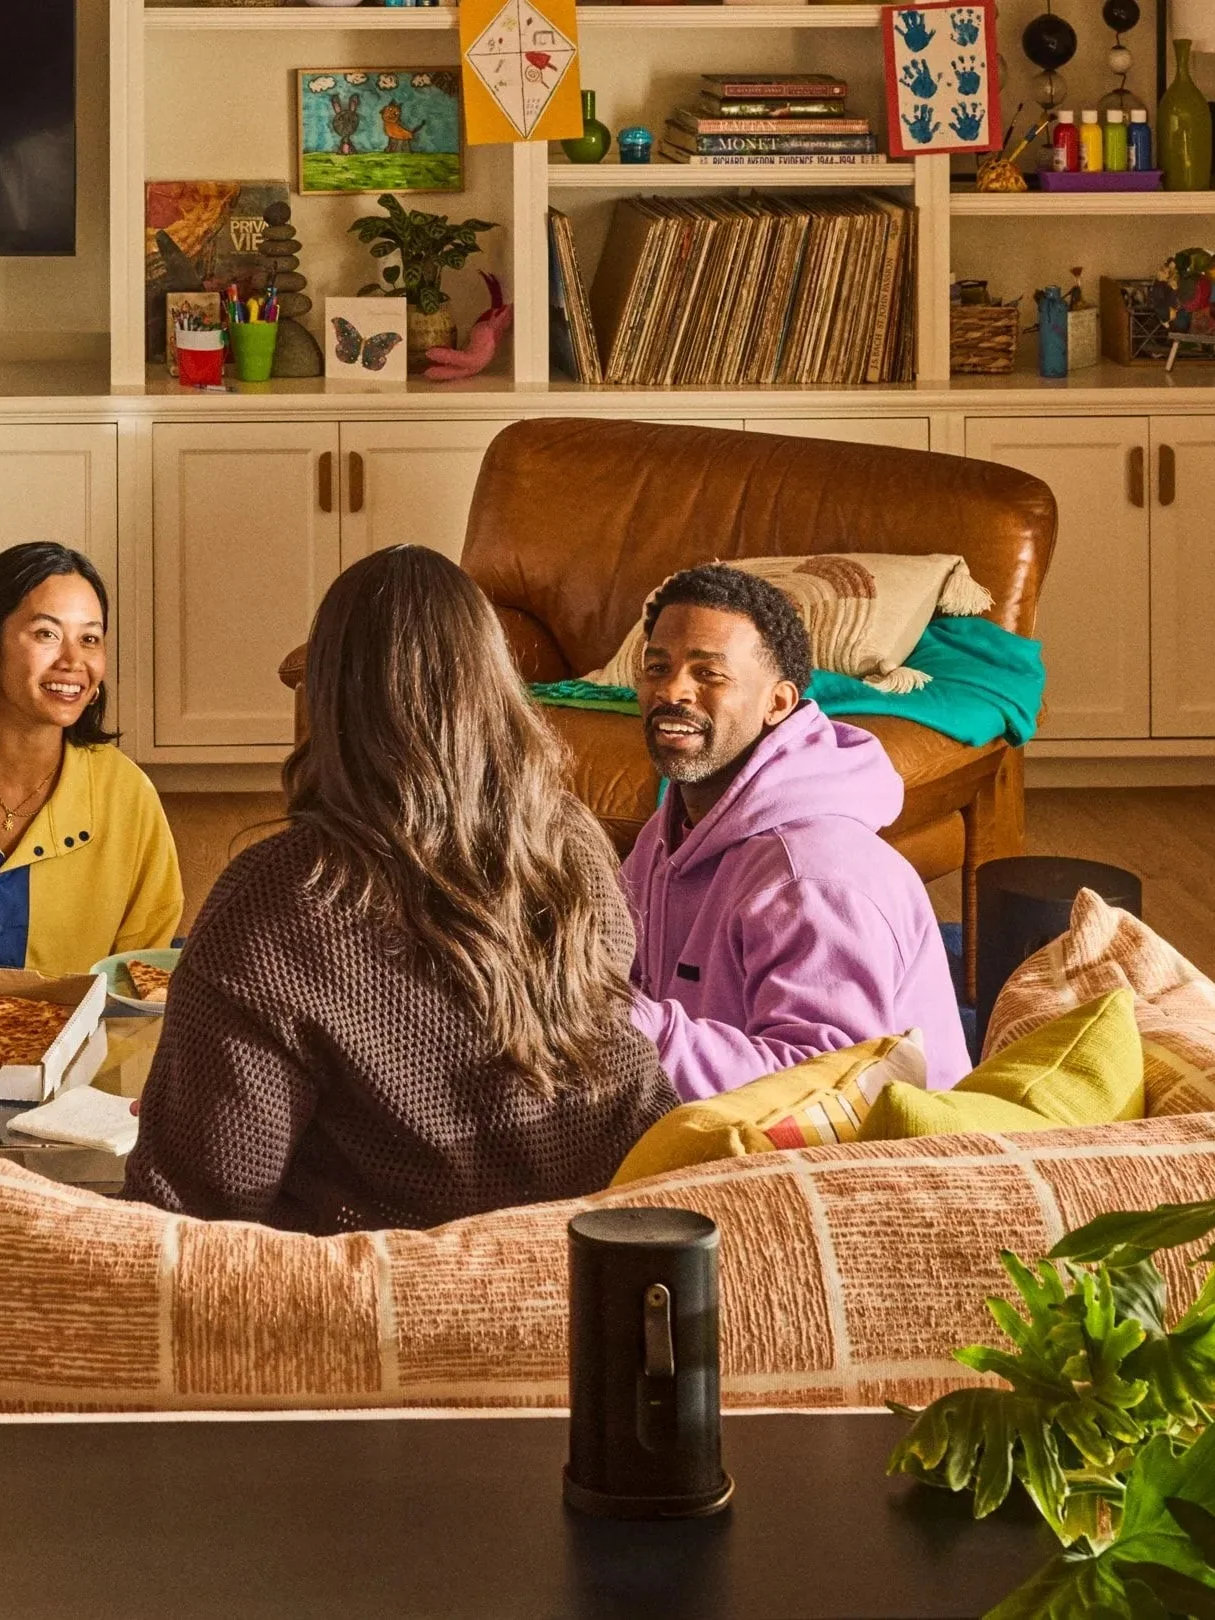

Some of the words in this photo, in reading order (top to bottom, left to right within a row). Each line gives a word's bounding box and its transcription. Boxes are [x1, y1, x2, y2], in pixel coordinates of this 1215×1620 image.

[718, 120, 778, 132] RATTAN
[719, 137, 780, 151] MONET
[712, 156, 745, 165] RICHARD
[747, 156, 775, 165] AVEDON
[778, 156, 814, 165] EVIDENCE
[230, 220, 269, 233] PRIVA
[230, 232, 265, 251] VIE
[873, 333, 883, 357] BACH
[878, 294, 888, 319] JOHN
[883, 257, 894, 293] PASSION
